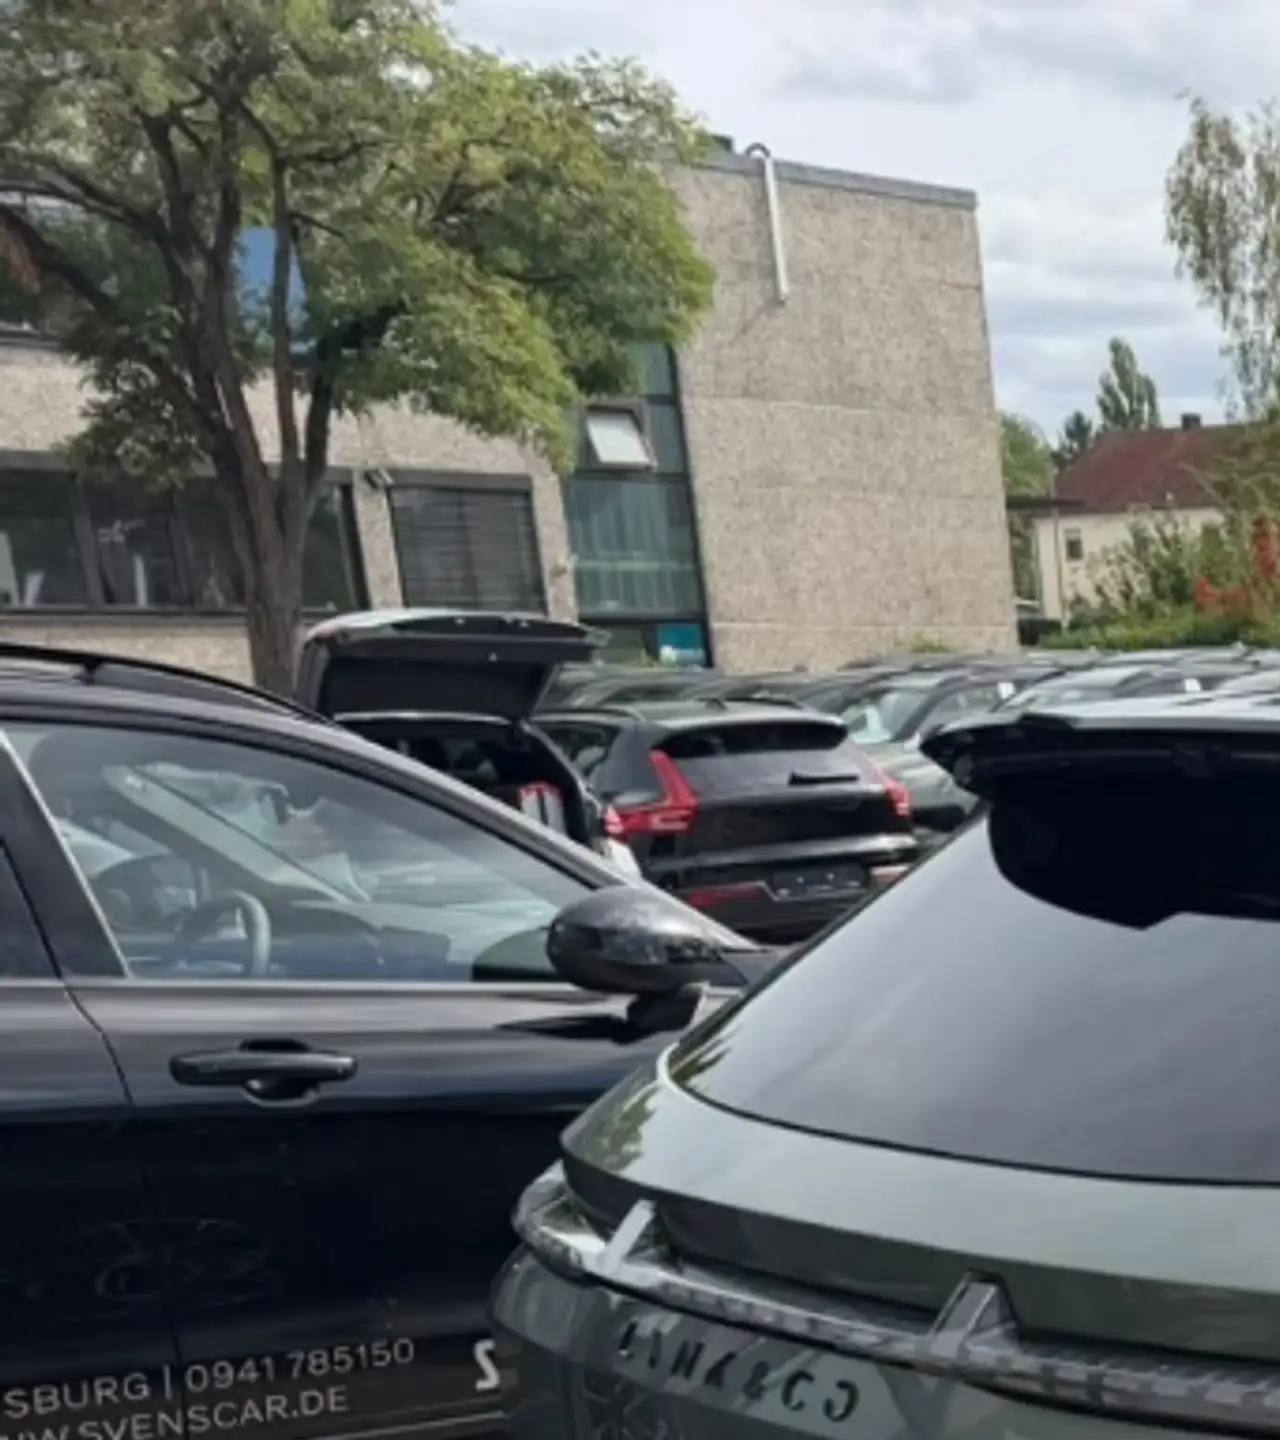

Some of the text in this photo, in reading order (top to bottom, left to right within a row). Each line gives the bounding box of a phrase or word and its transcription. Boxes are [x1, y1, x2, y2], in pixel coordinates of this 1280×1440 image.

[3, 1372, 150, 1420] SBURG
[185, 1356, 275, 1393] 0941
[288, 1337, 415, 1379] 785150
